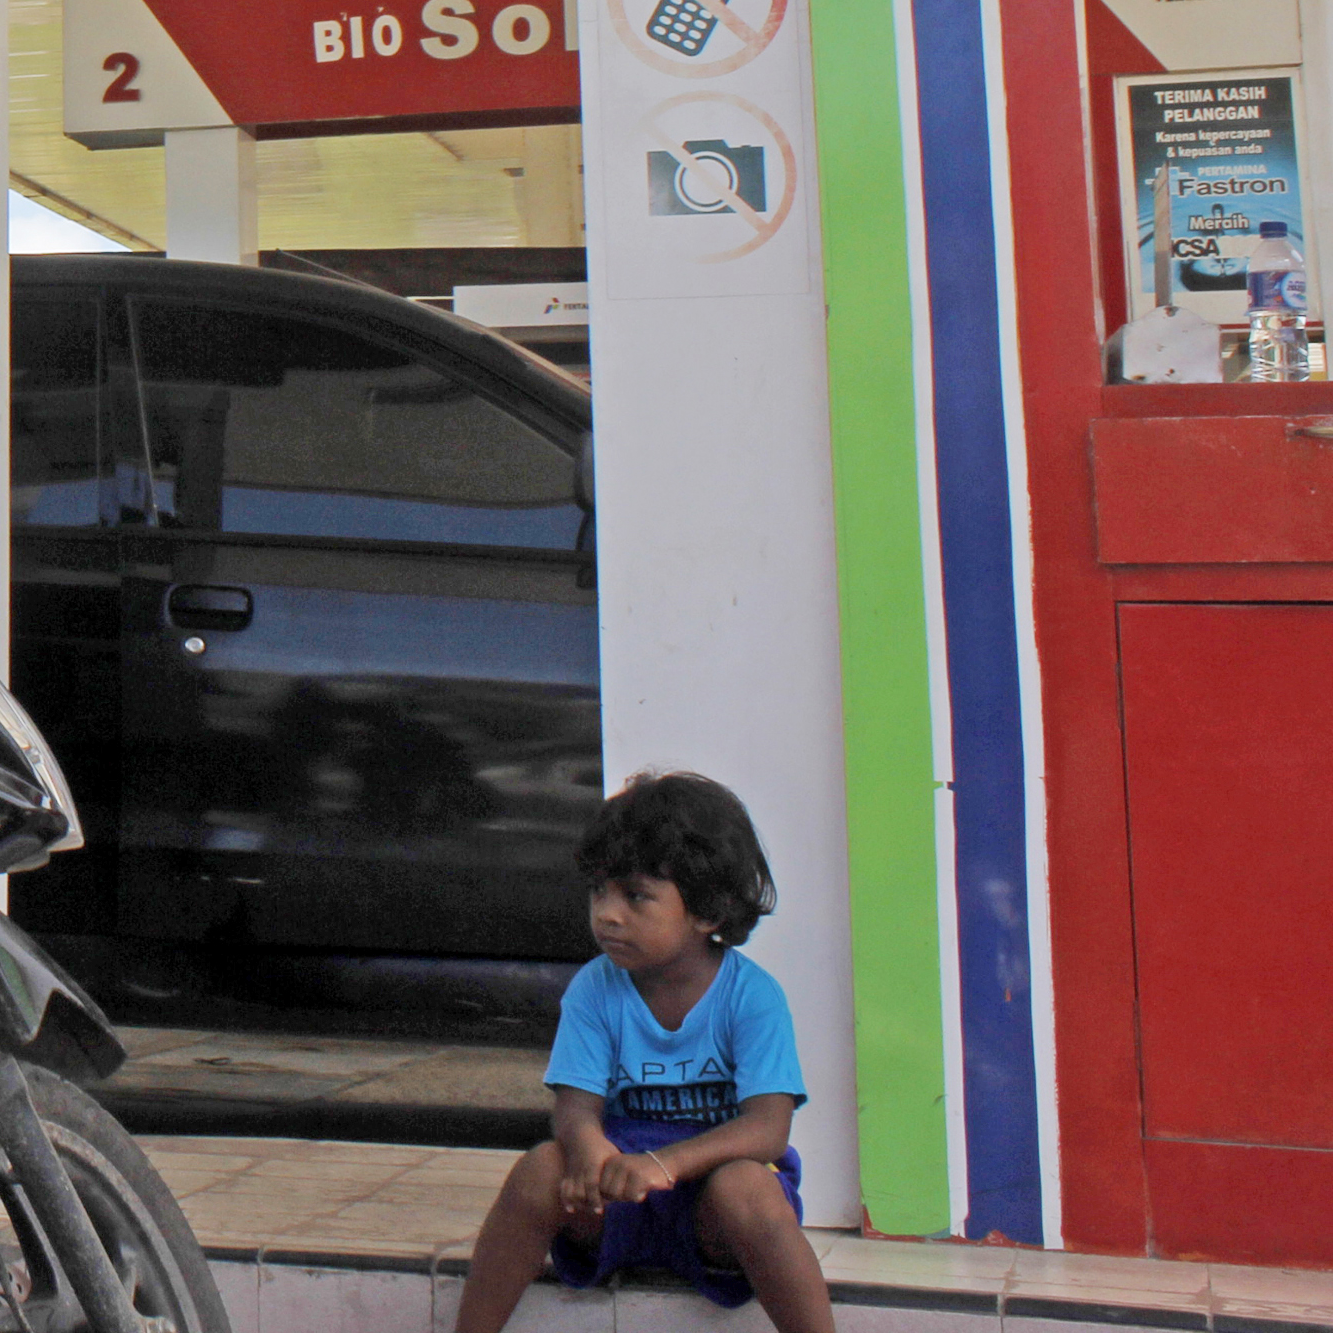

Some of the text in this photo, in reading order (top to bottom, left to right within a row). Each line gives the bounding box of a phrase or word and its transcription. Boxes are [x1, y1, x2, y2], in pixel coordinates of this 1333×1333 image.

[313, 13, 402, 63] BIO
[102, 52, 141, 104] 2
[1153, 86, 1268, 105] TERIMA KASIH
[1163, 105, 1261, 123] PELANGGAN
[1155, 129, 1271, 143] Karena kepercayaan
[1166, 145, 1264, 159] & kepuasan anda
[1198, 165, 1268, 176] PERTAMINA
[1177, 177, 1287, 197] Fastron
[1188, 213, 1250, 232] Meraih
[628, 1086, 735, 1112] AMERICA
